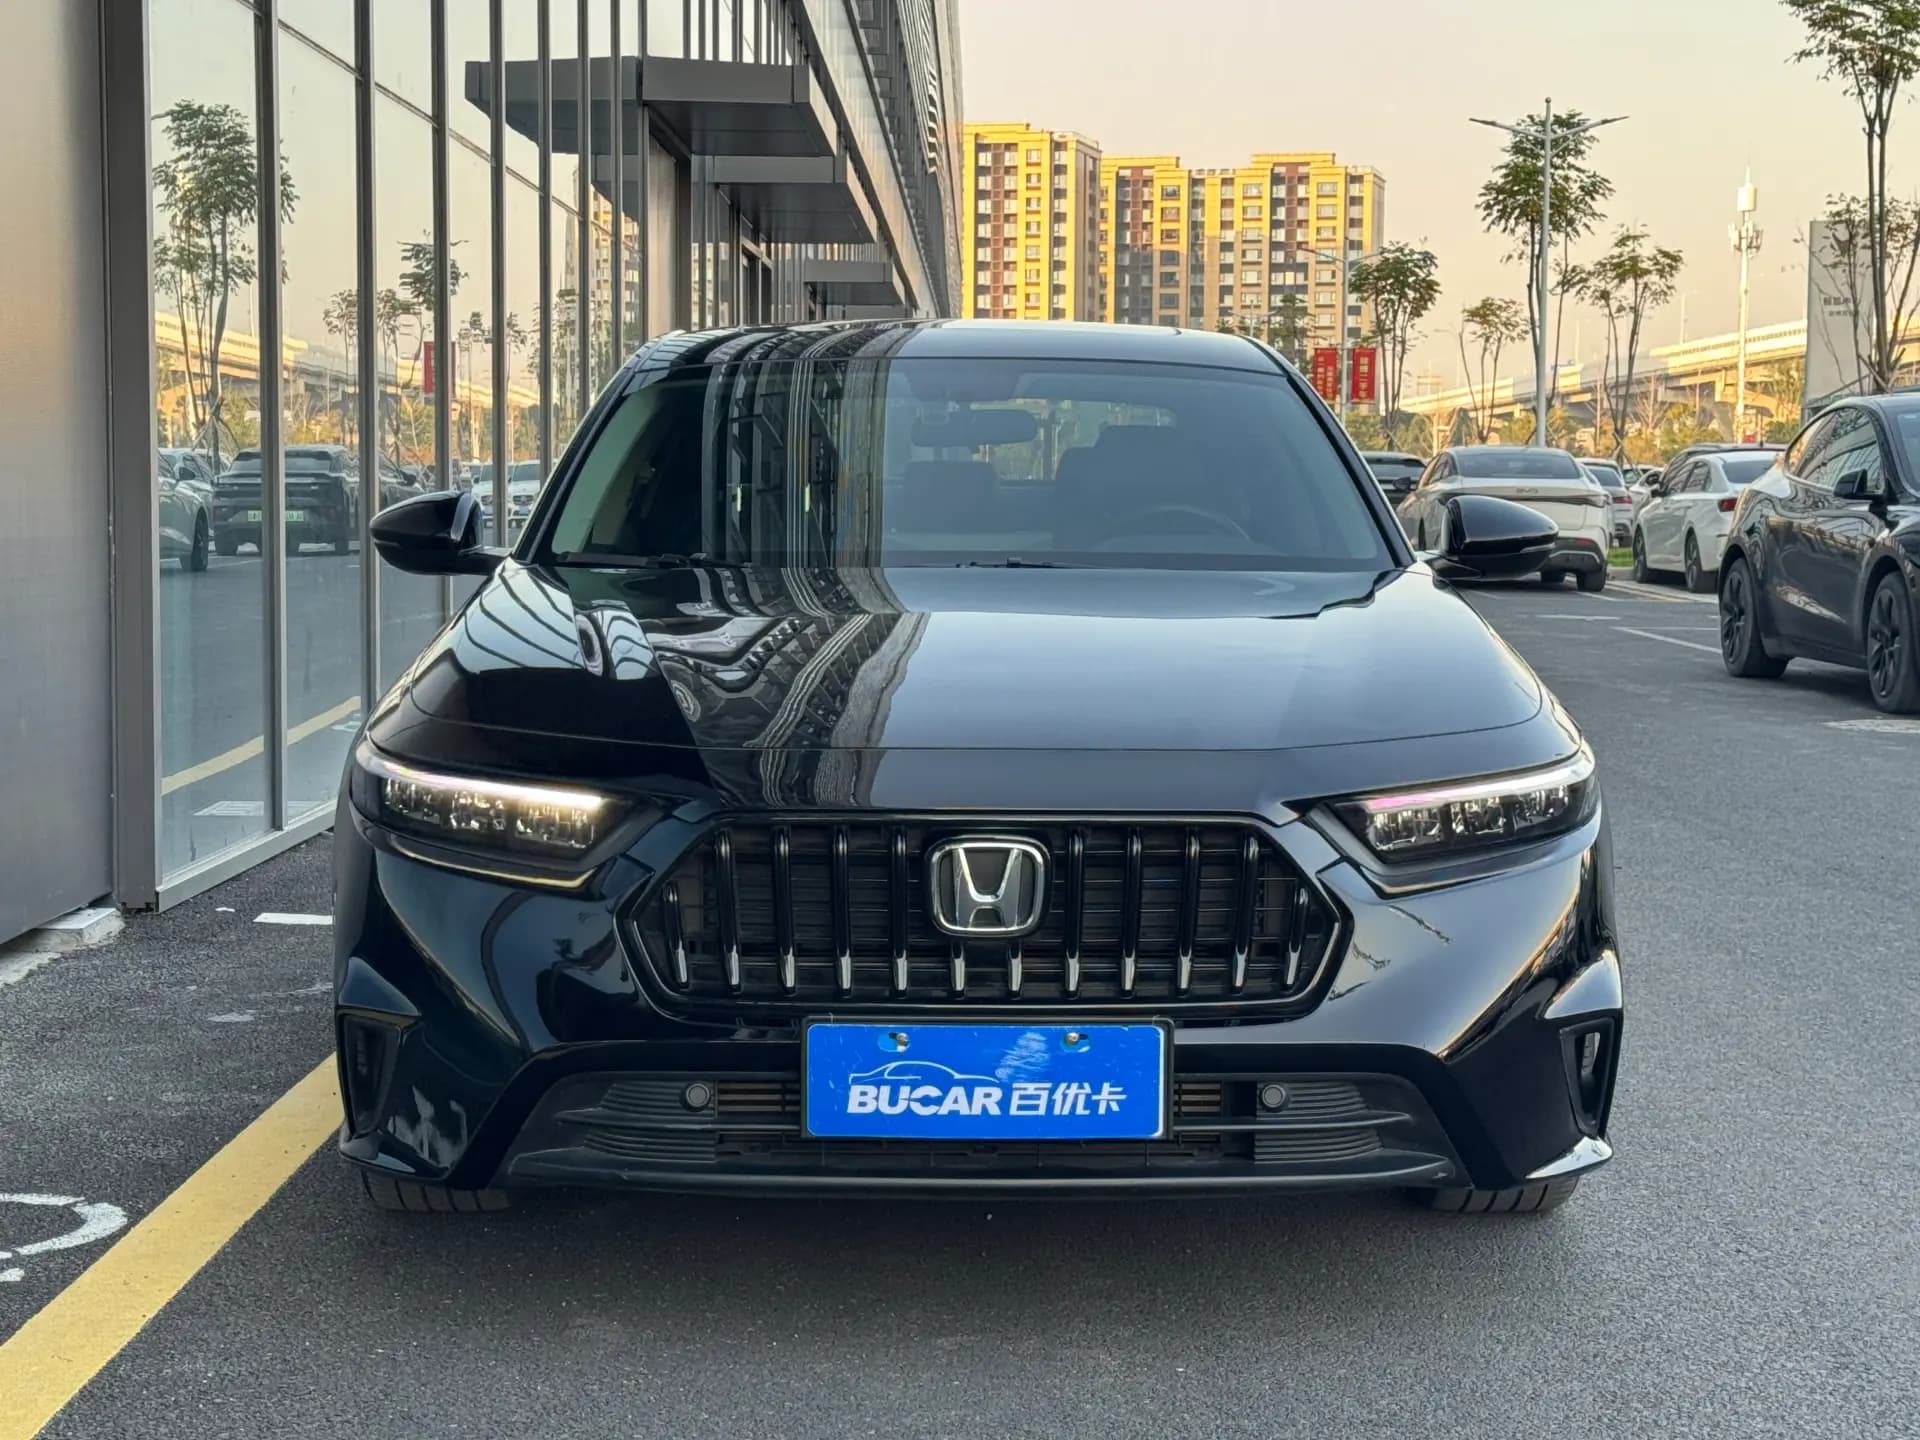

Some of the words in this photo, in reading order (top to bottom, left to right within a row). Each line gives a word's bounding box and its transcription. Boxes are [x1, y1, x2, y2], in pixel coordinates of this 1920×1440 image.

[847, 1084, 1003, 1116] BUCAR
[1009, 1082, 1127, 1116] 百优卡
